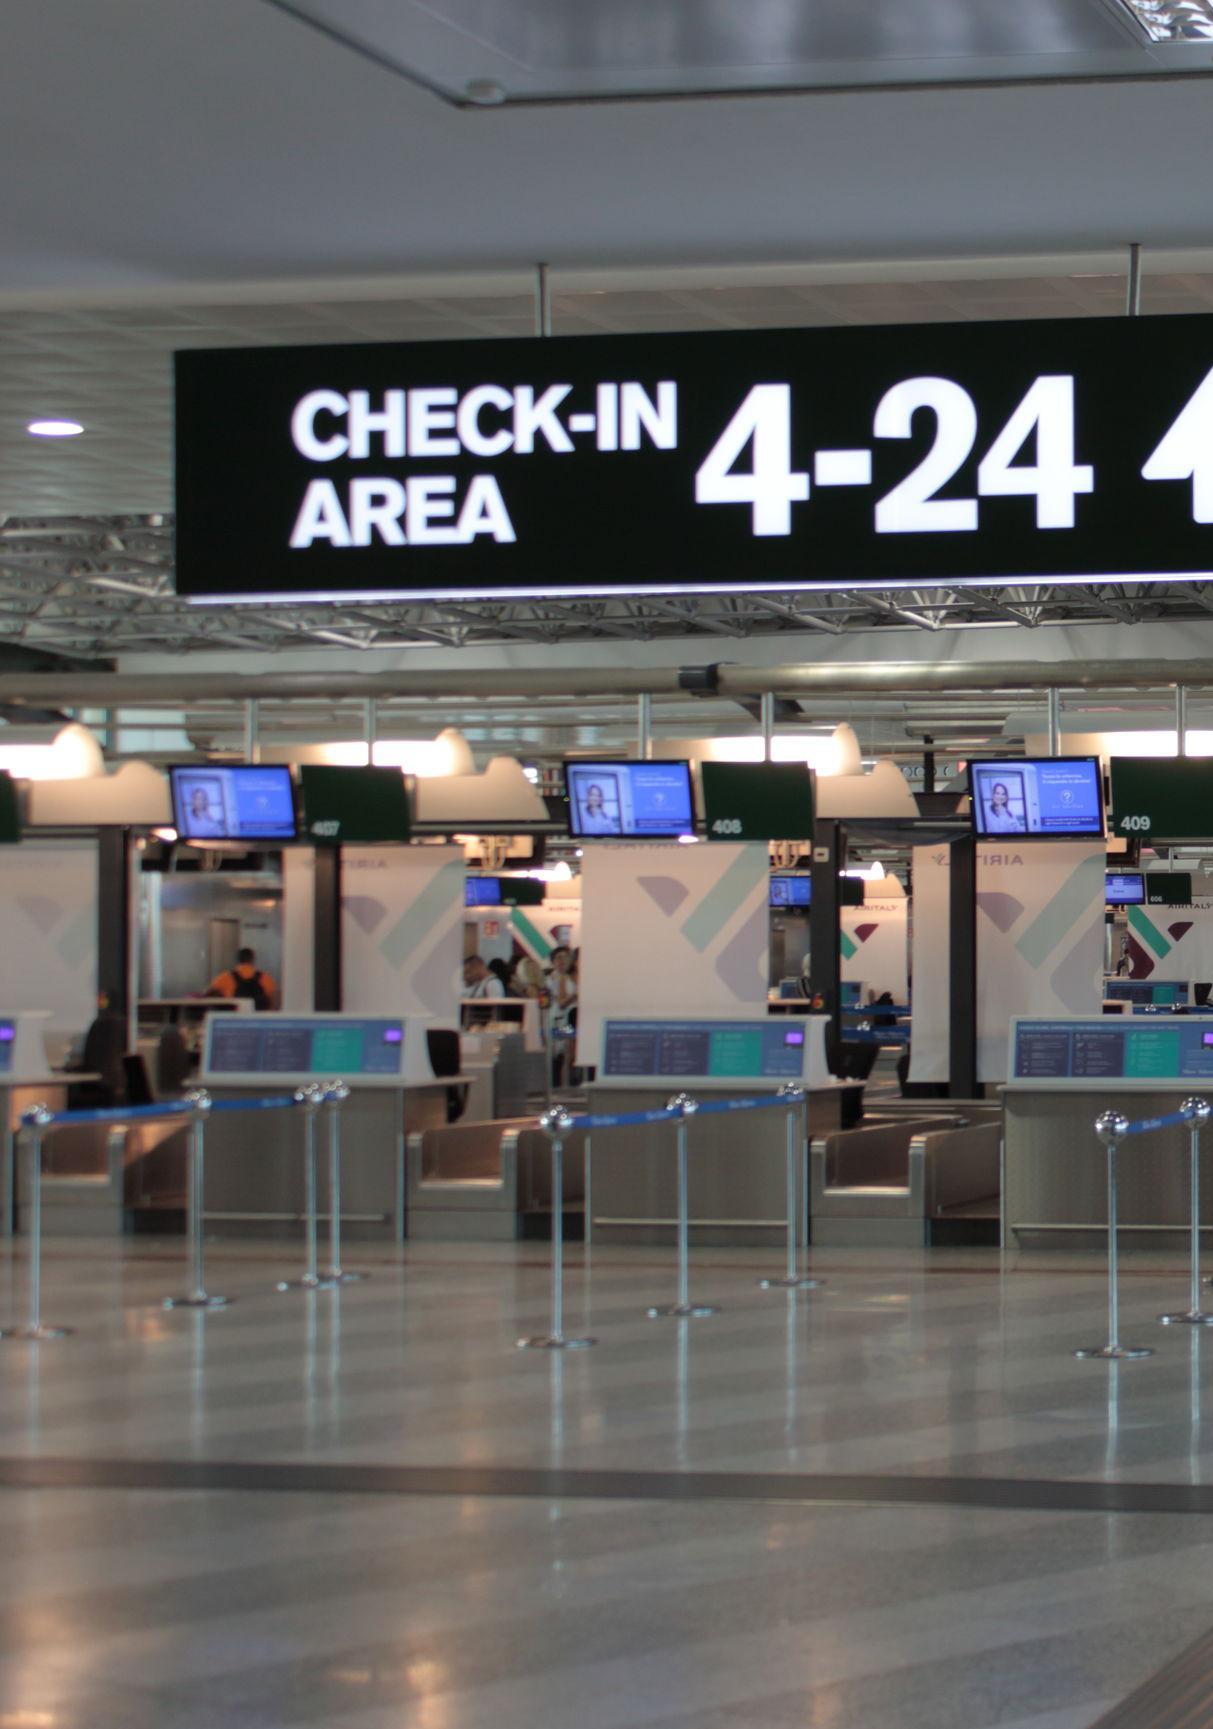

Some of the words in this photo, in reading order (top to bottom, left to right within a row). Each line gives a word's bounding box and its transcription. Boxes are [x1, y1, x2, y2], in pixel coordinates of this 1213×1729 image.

[291, 381, 678, 462] CHECK-IN
[696, 375, 1094, 537] 4-24
[289, 475, 517, 549] AREA
[712, 819, 742, 834] 408
[1121, 815, 1151, 831] 409
